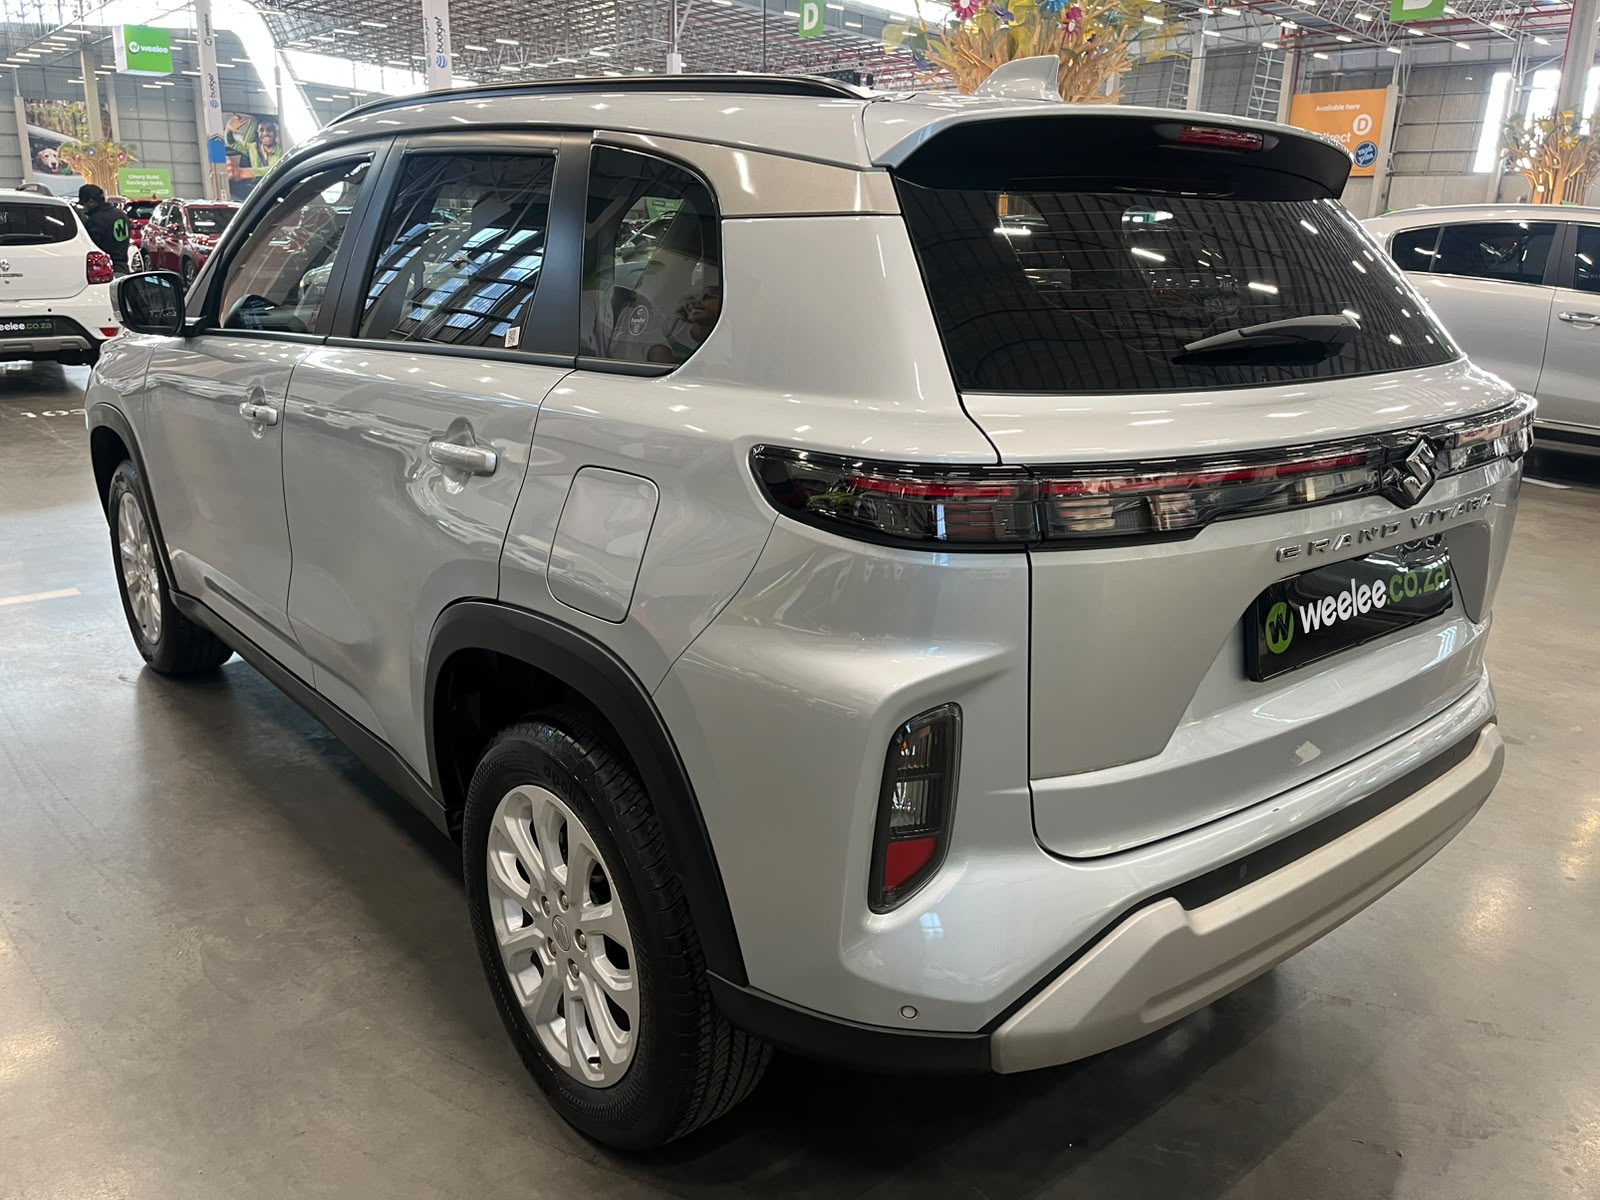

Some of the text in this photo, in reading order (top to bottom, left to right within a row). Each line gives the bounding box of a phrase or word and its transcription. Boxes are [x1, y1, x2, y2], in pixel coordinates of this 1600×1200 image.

[434, 16, 445, 53] budget
[803, 2, 819, 30] D
[1315, 104, 1344, 112] Available
[1276, 493, 1492, 562] GRAND VITARA
[1300, 563, 1447, 634] weelee.co.za
